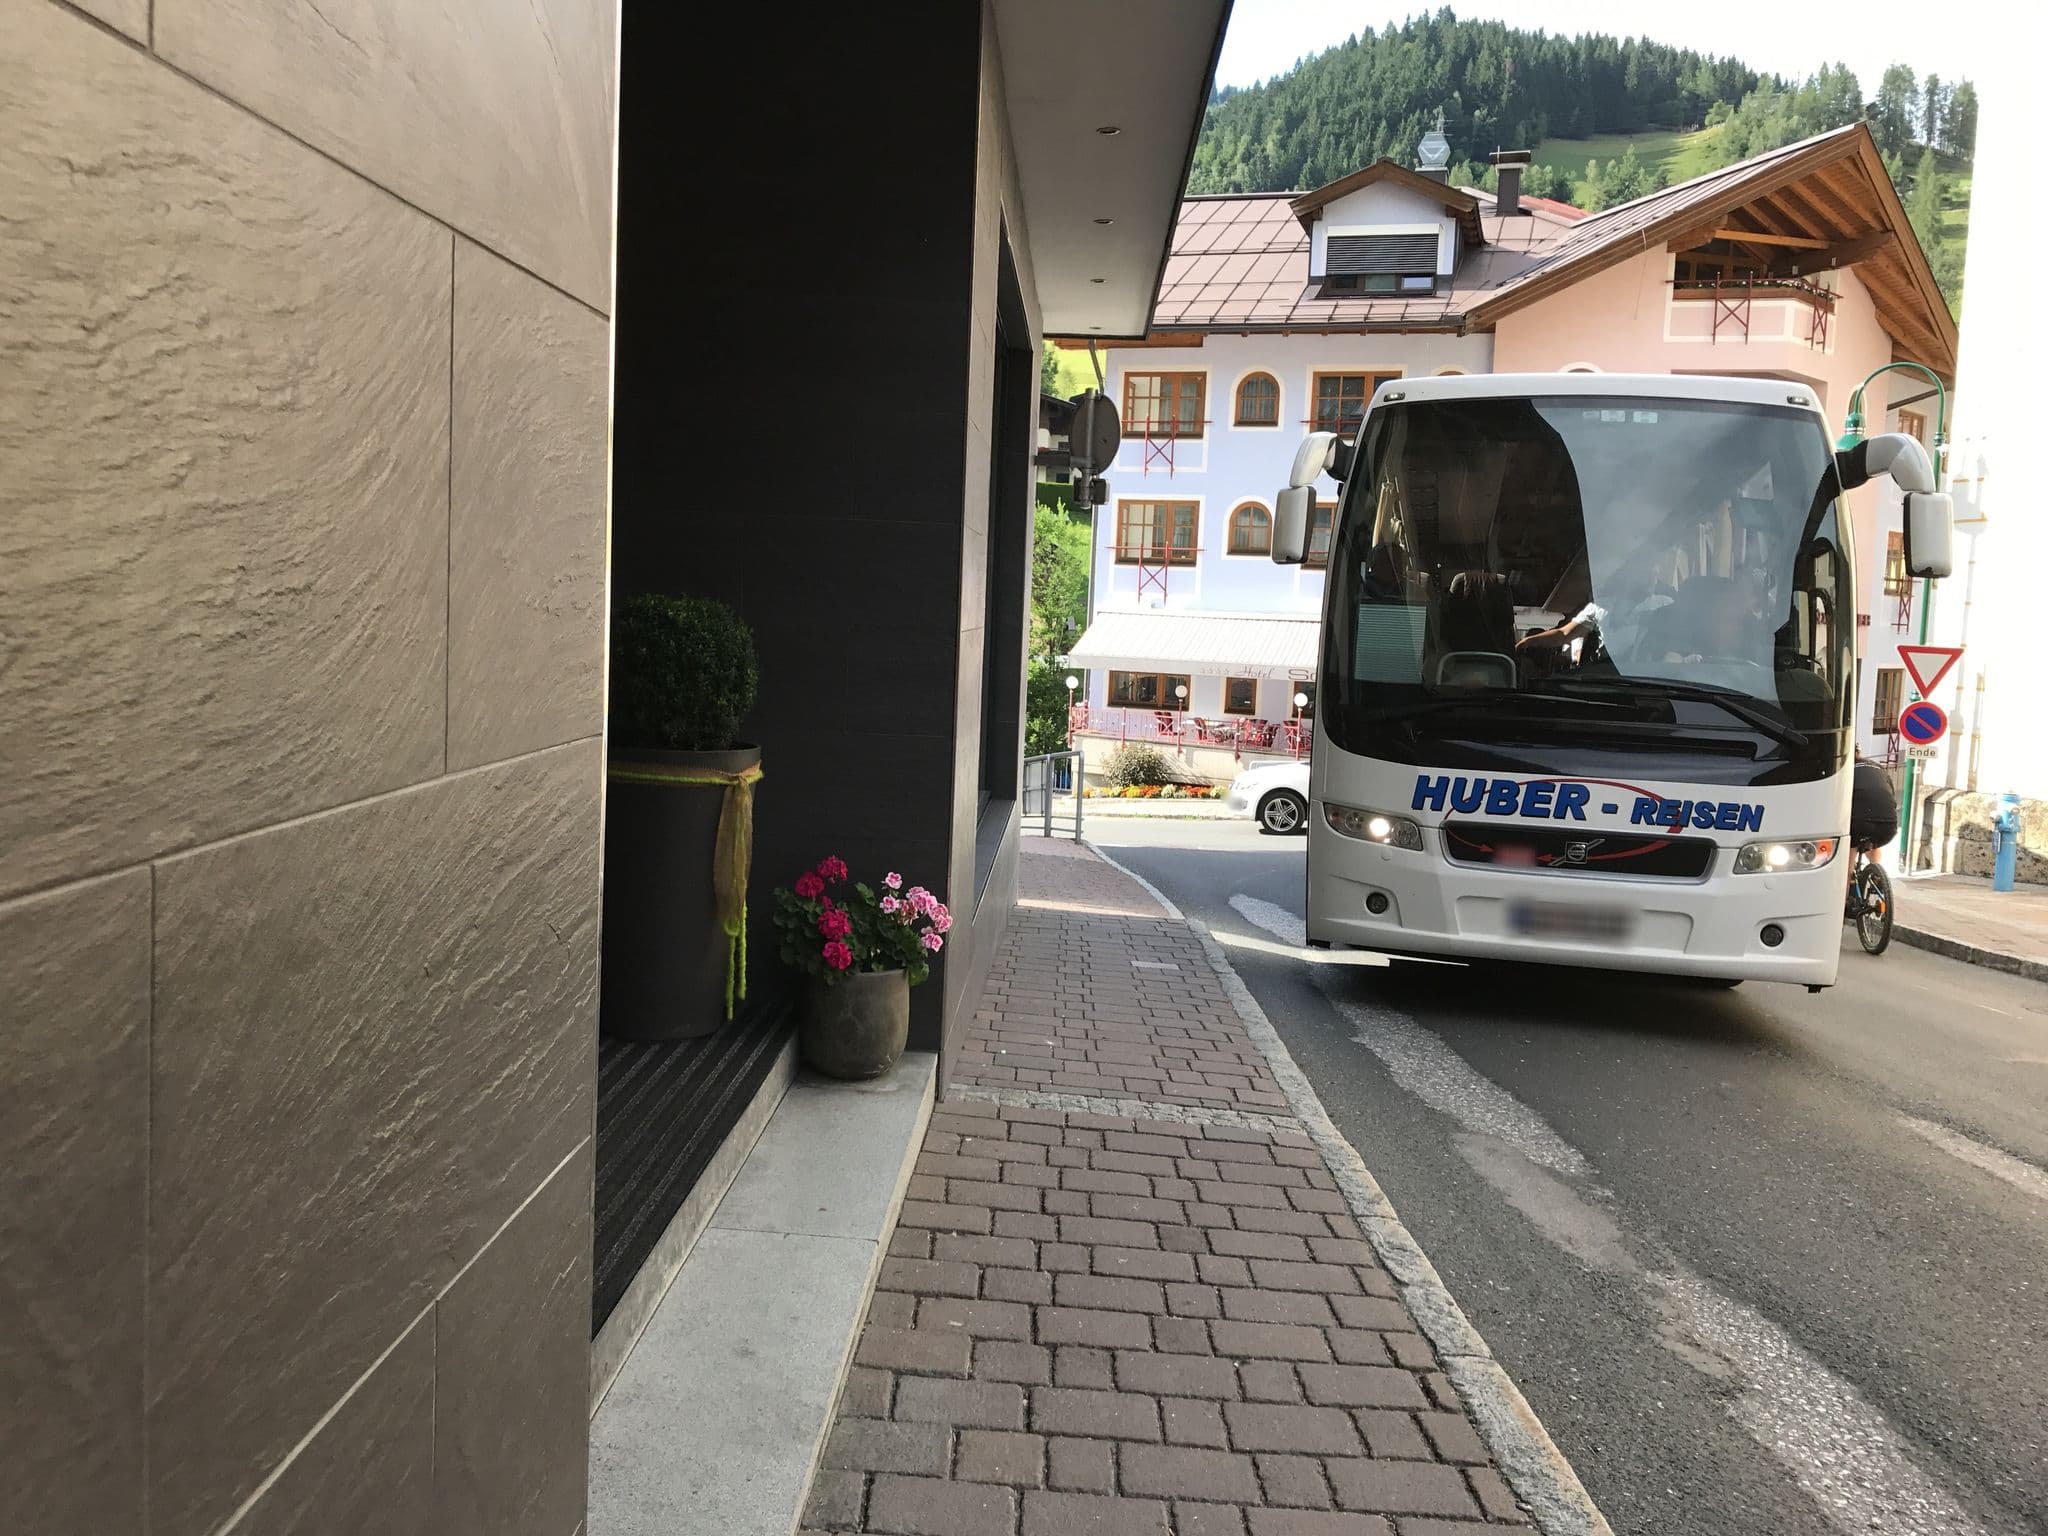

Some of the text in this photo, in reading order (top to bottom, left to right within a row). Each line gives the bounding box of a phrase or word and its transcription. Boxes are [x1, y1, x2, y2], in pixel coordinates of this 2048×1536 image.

[1235, 665, 1275, 679] Hotel
[1909, 747, 1936, 757] Ende
[1411, 775, 1591, 821] HUBER
[1630, 797, 1765, 832] REISEN
